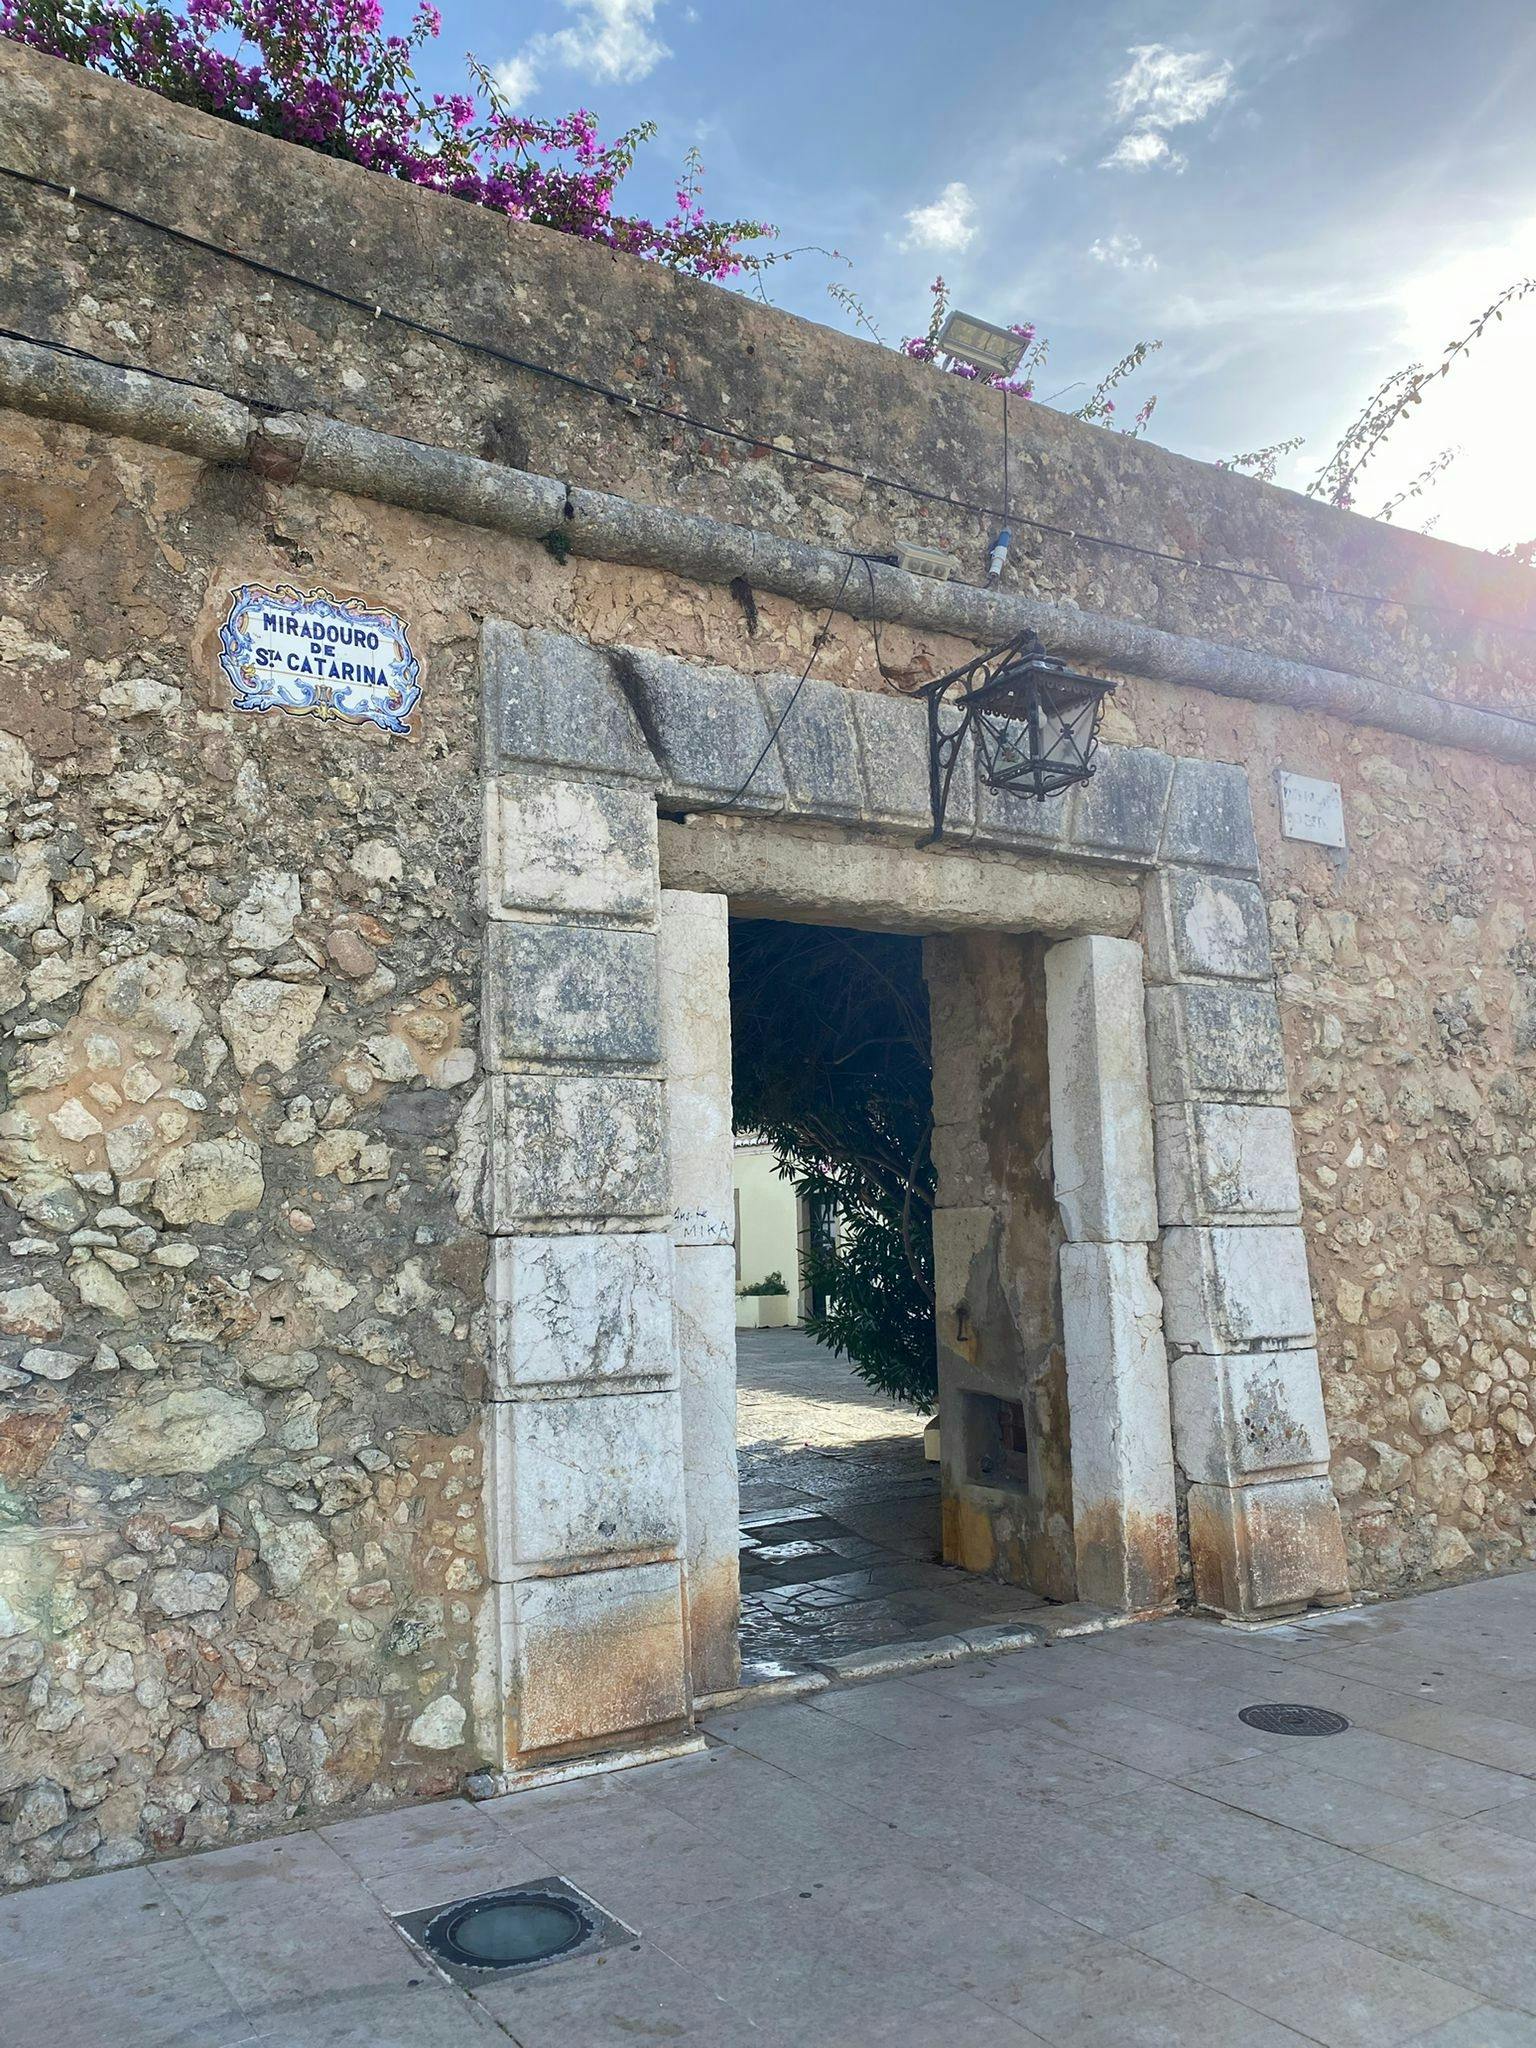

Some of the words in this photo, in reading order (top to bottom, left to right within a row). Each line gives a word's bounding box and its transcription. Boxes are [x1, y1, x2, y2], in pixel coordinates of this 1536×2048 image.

[263, 613, 379, 650] MIRADOURO
[310, 642, 336, 657] DE
[287, 653, 389, 687] CATARINA
[683, 1220, 730, 1239] MIKA
